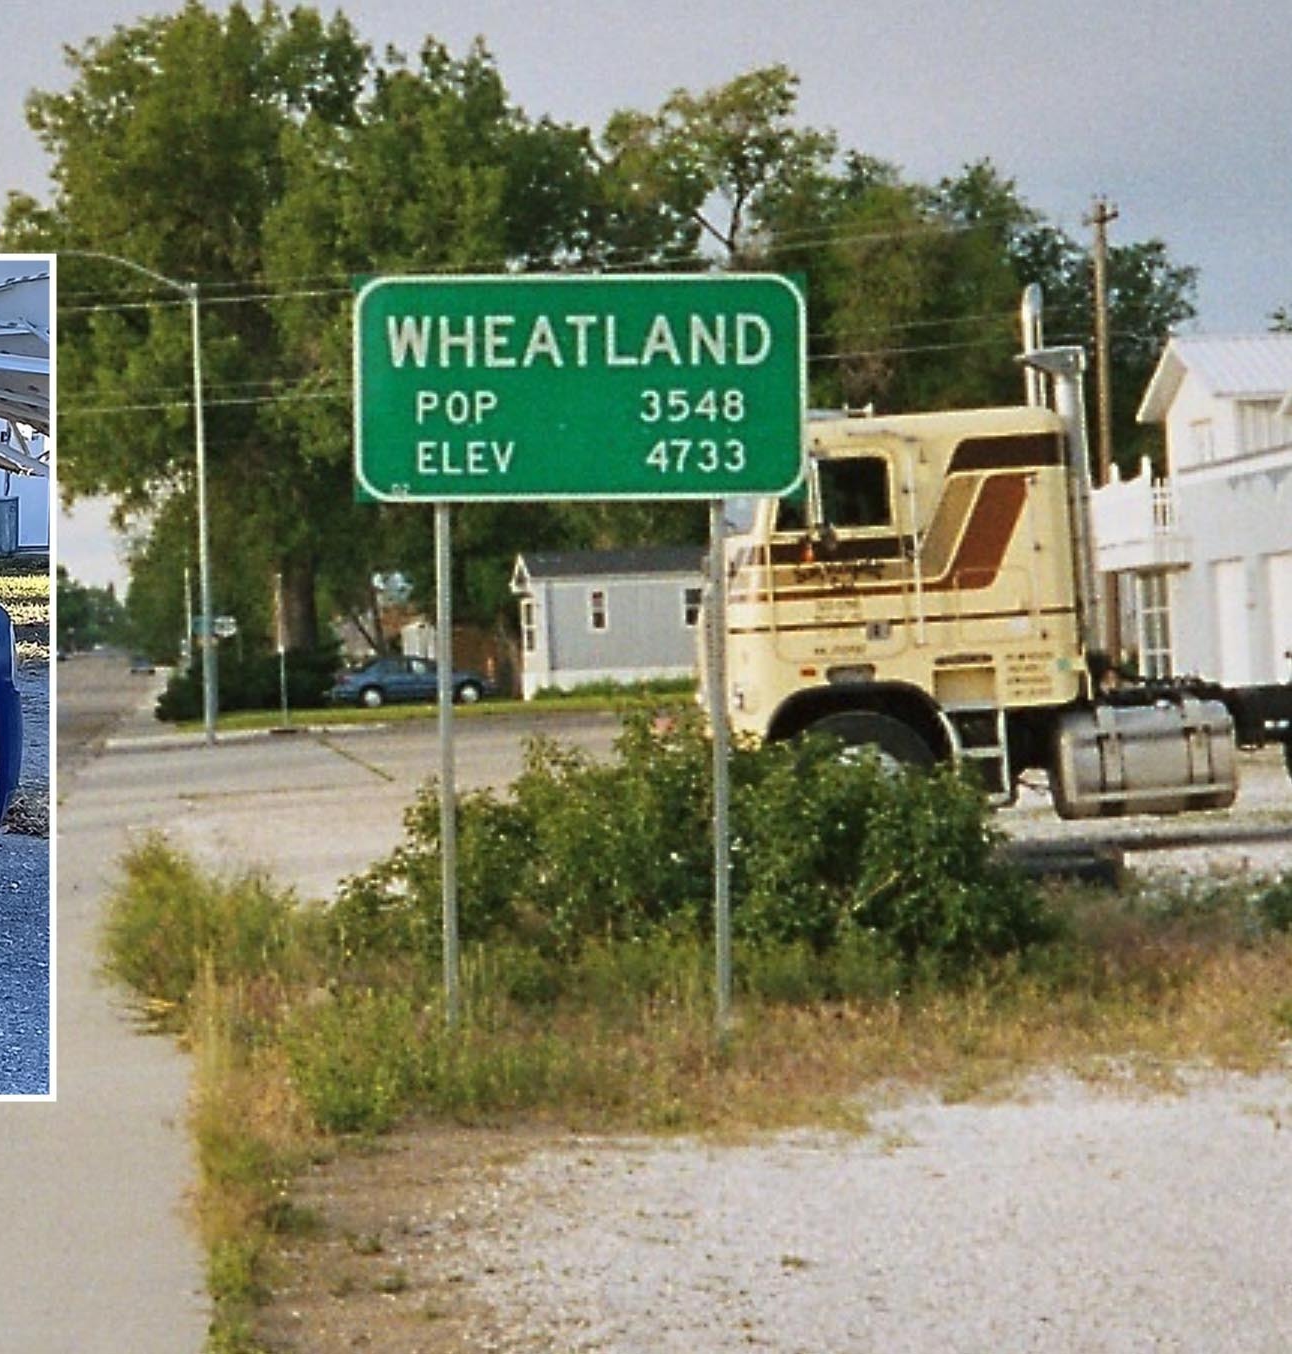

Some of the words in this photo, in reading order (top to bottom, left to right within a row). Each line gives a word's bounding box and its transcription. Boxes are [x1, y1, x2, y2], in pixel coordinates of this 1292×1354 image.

[387, 314, 772, 368] WHEATLAND
[416, 391, 498, 425] POP
[640, 390, 745, 422] 3548
[417, 441, 515, 474] ELEV
[645, 440, 746, 472] 4733
